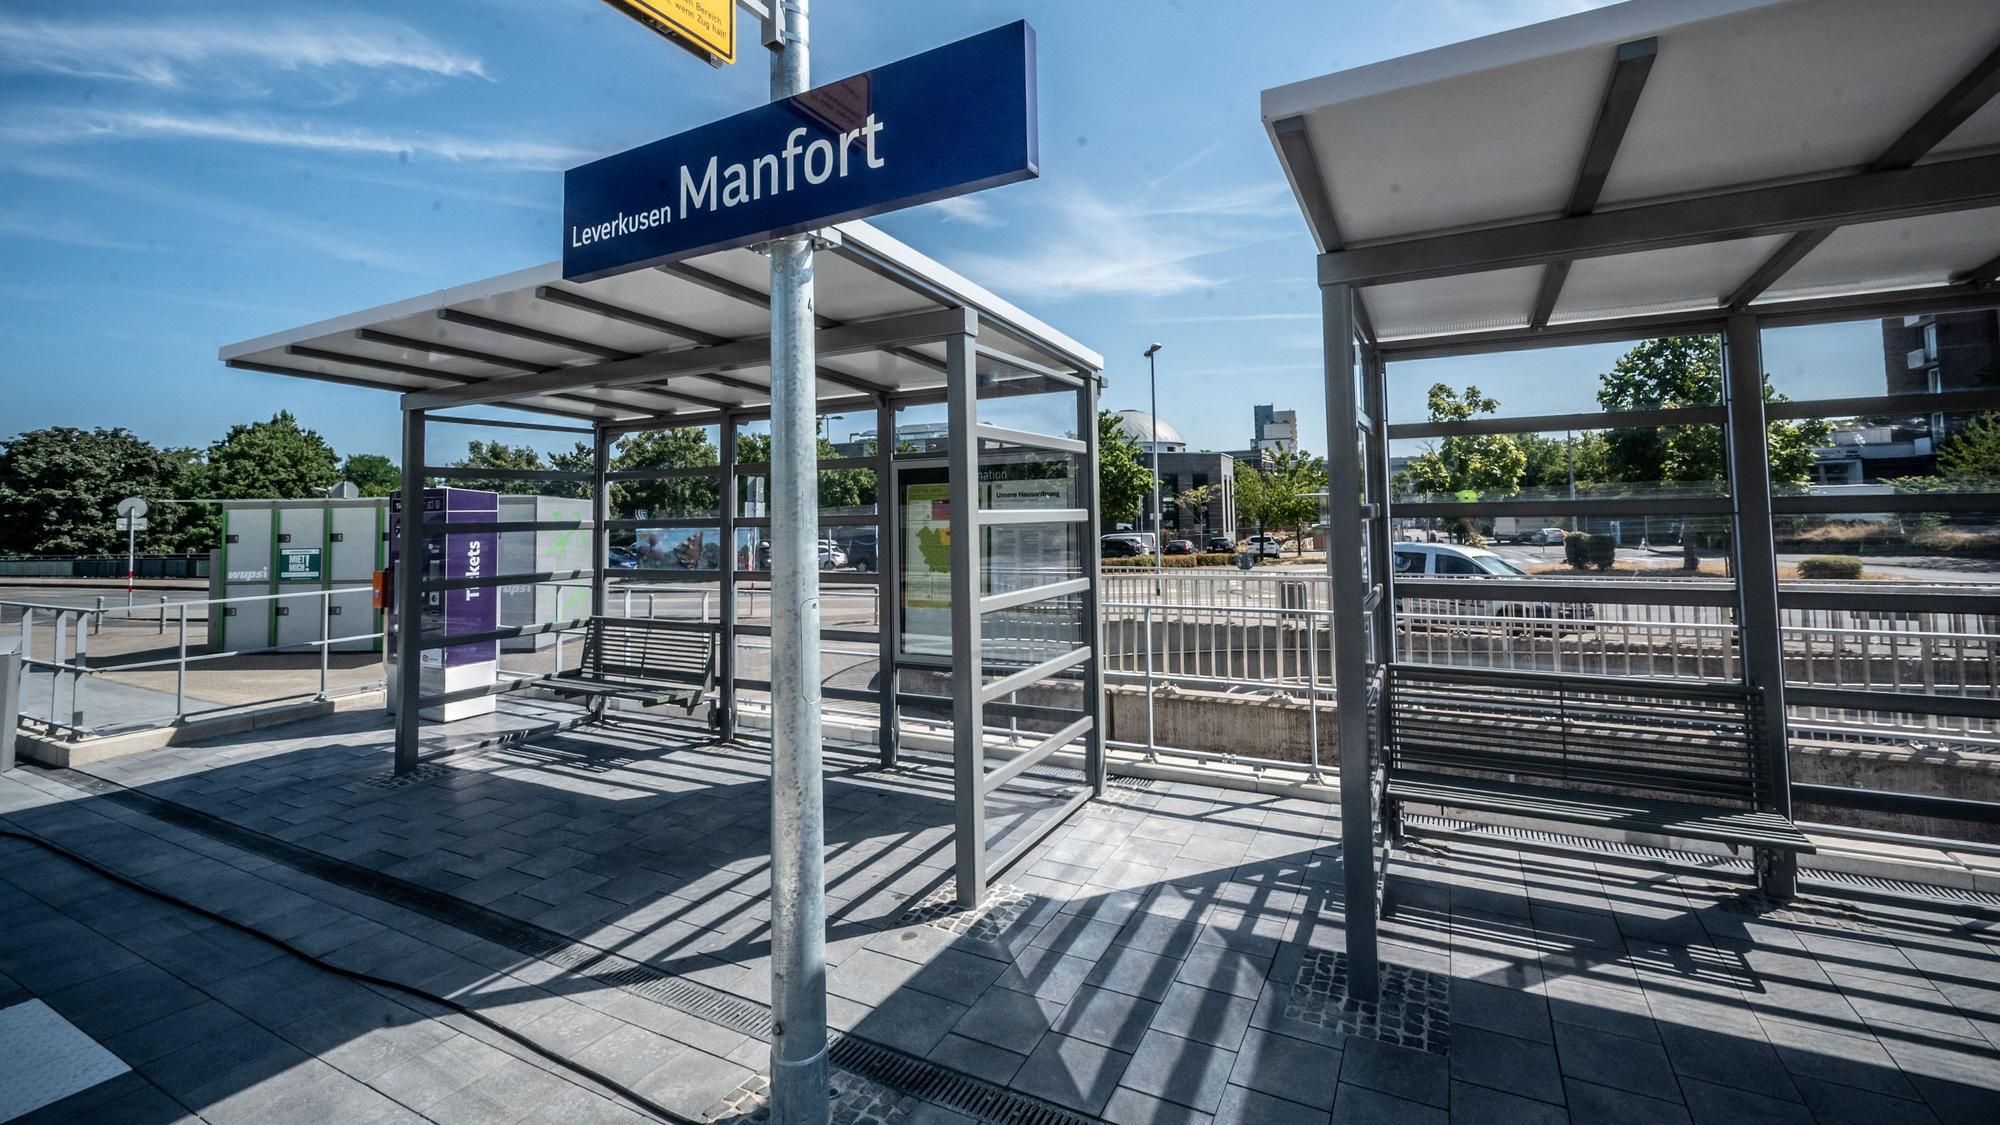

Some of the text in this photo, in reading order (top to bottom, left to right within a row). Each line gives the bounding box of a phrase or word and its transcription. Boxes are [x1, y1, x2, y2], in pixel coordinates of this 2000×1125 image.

[674, 2, 694, 18] wenn
[697, 14, 710, 31] Zug
[695, 2, 722, 26] Bereich
[572, 113, 885, 248] Leverkusen Manfort
[1018, 490, 1060, 498] Hausordnung
[289, 555, 305, 563] MIET
[465, 540, 480, 601] Tikets
[228, 566, 267, 581] wupsi
